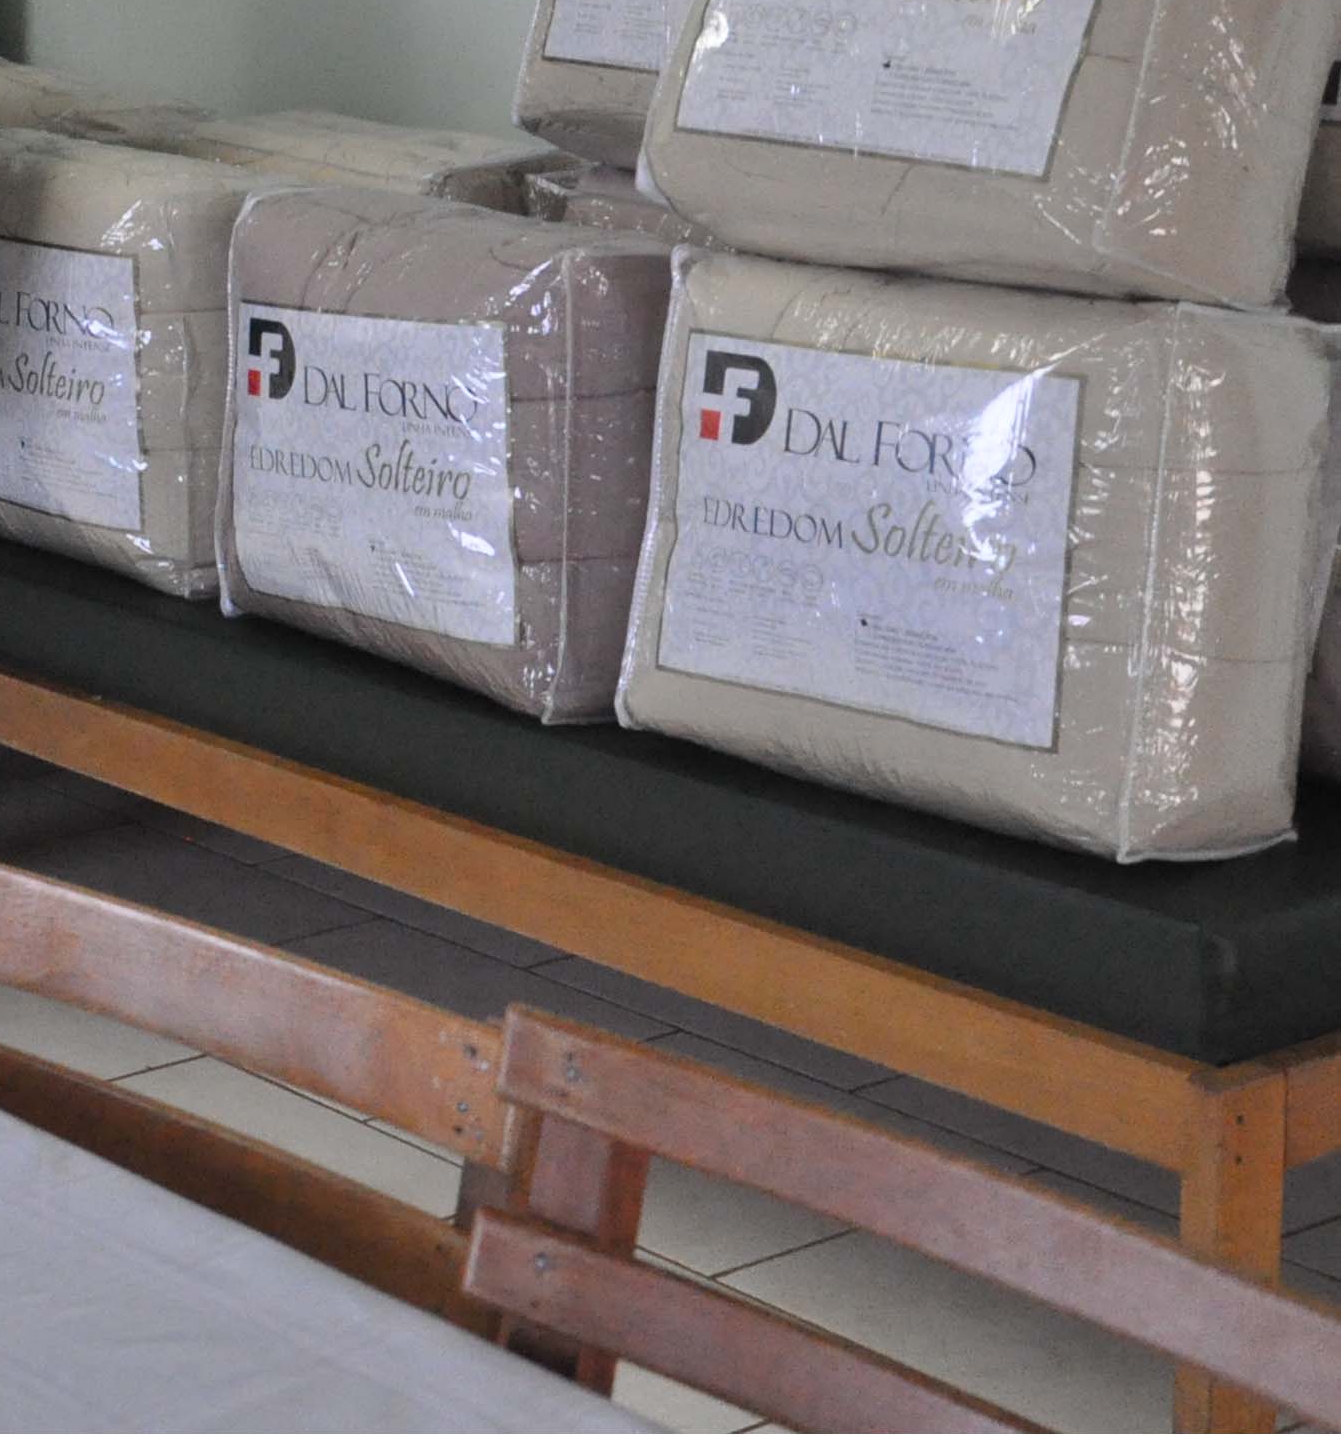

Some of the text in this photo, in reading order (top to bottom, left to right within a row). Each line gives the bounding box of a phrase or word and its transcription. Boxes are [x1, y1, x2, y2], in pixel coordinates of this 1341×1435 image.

[15, 290, 115, 339] FORNO
[7, 350, 105, 405] Solteiro
[303, 365, 479, 423] DAL FORNO
[250, 439, 472, 500] EDREDOM Solteiro
[783, 408, 1037, 487] DAL FORO
[703, 496, 844, 550] EDREDOM
